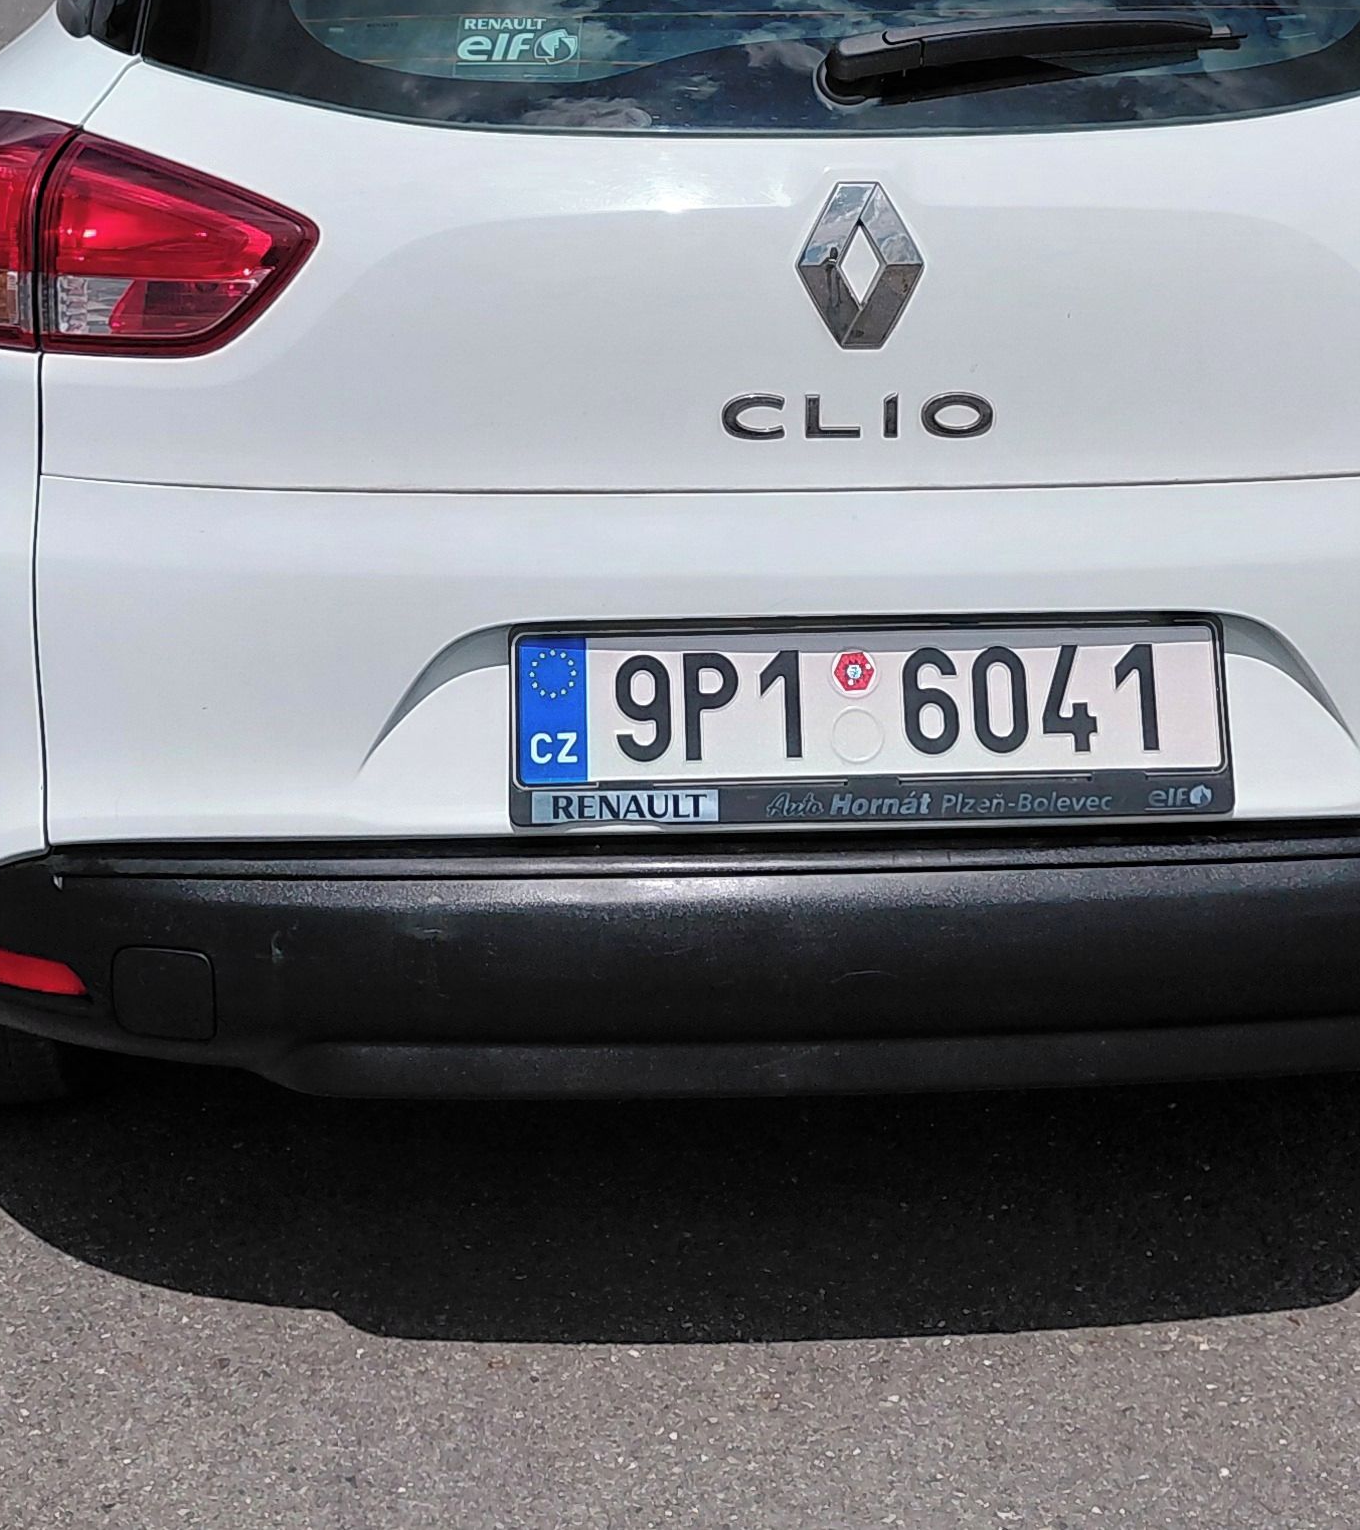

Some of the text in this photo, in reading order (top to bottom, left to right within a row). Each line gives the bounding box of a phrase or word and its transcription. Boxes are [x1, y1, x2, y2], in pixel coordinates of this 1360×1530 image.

[463, 18, 547, 30] RENAULT
[456, 32, 535, 62] elf
[720, 391, 995, 440] CLIO
[614, 643, 1162, 763] 9P1 6041
[529, 731, 579, 765] CZ
[551, 793, 708, 820] RENAULT
[766, 790, 1114, 818] Auto Hornát Plzeň-Bolevec
